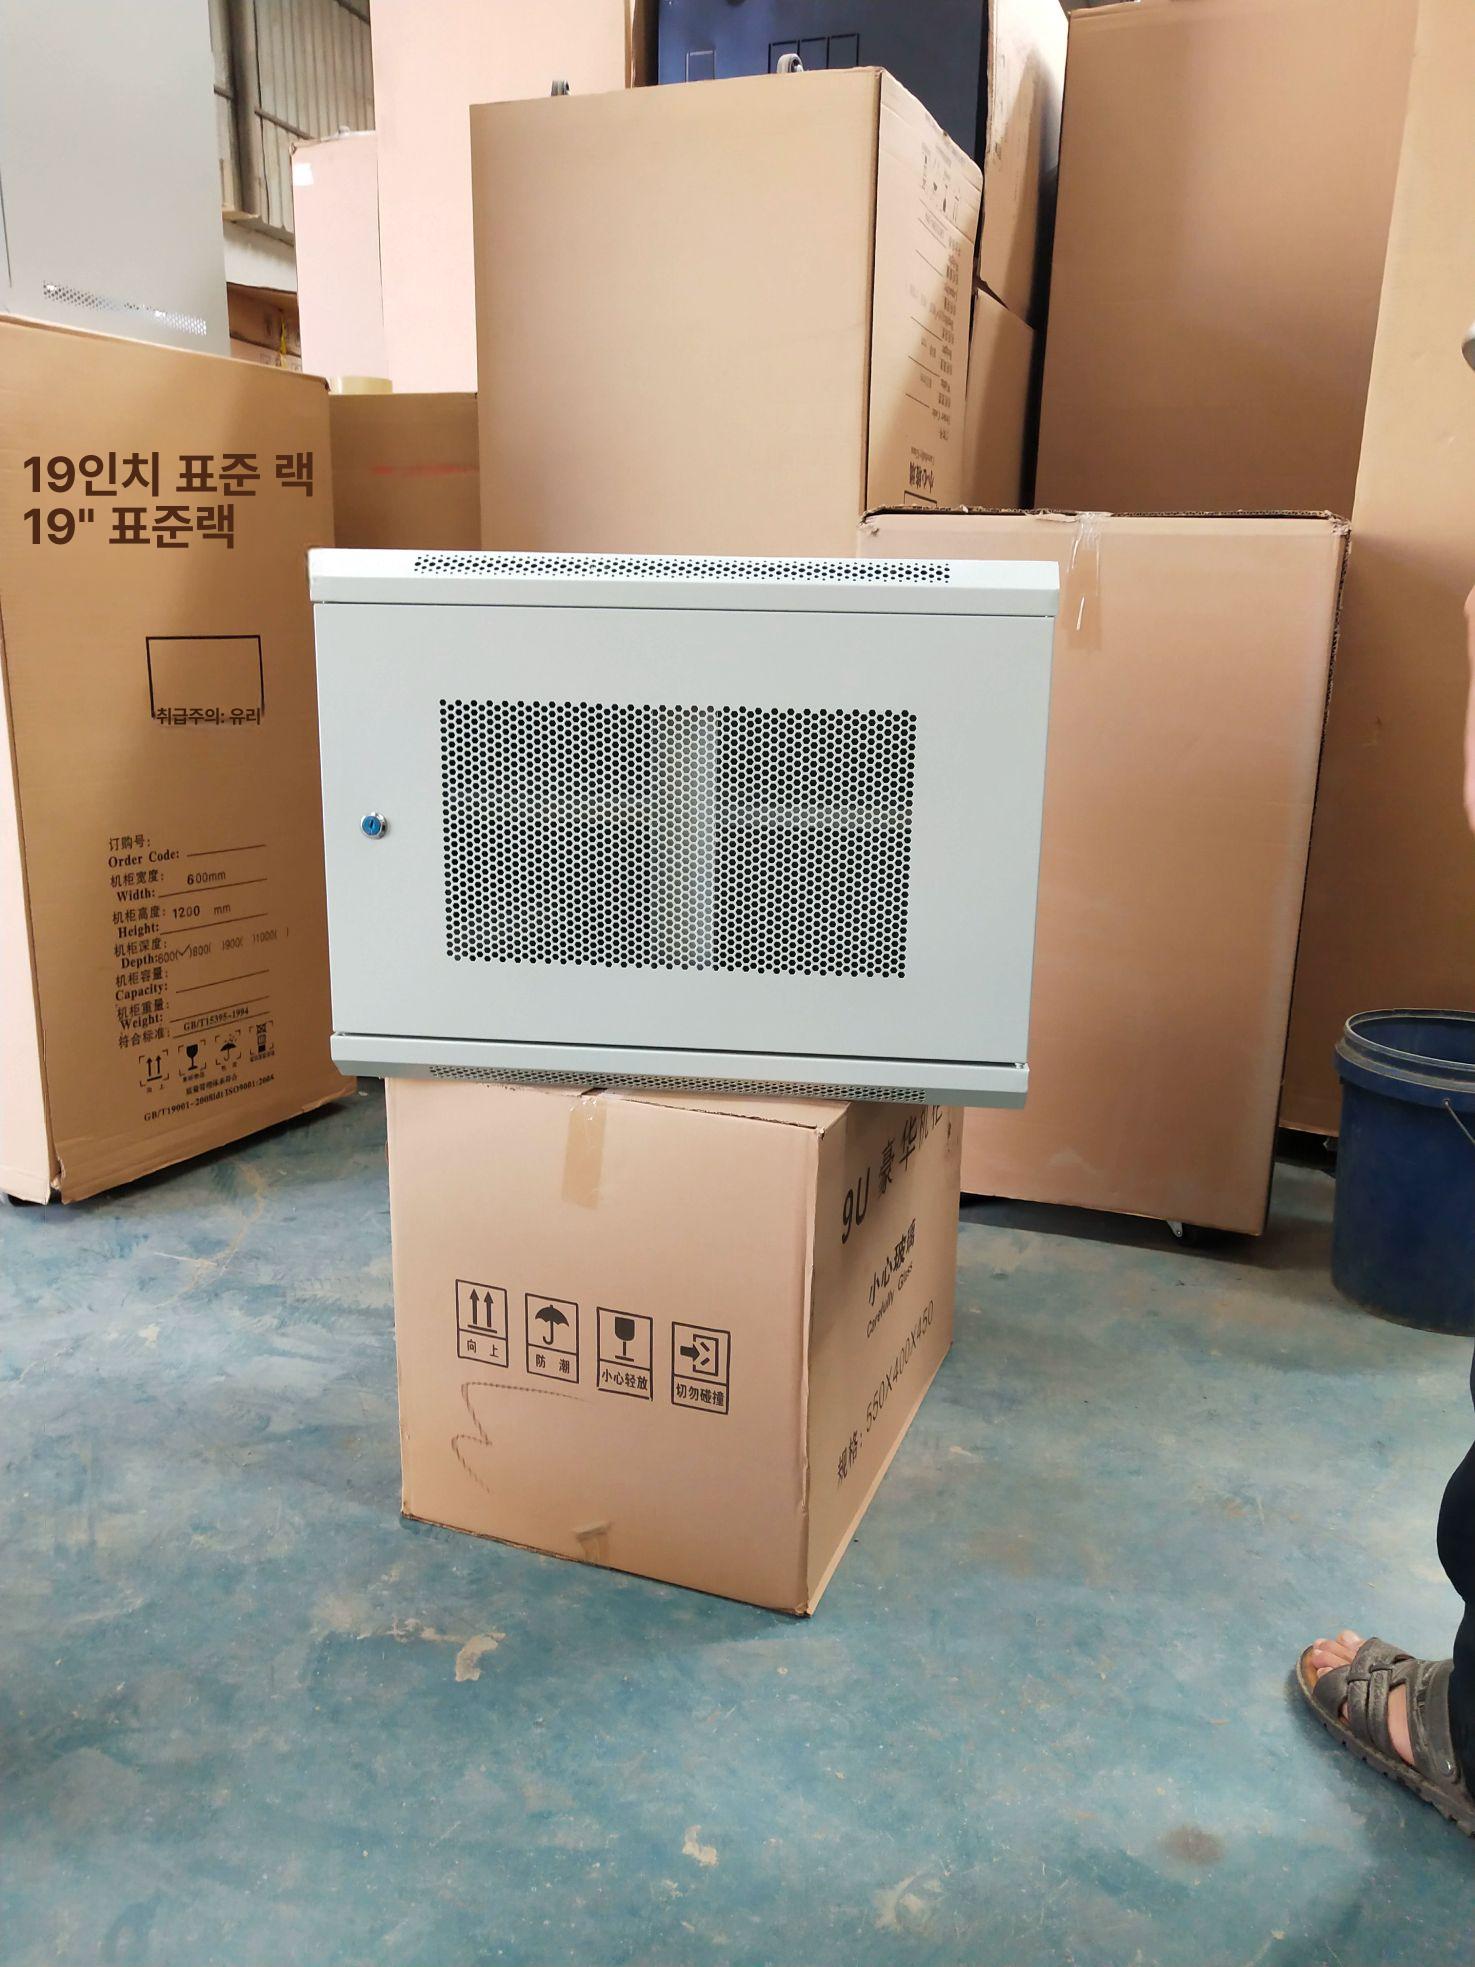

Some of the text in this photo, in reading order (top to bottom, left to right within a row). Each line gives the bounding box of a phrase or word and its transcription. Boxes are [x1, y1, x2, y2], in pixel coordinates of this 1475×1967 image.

[23, 452, 313, 497] 19인치 표준 랙
[23, 504, 234, 549] 19" 표준랙
[156, 708, 261, 726] 취급주의: 유리
[108, 849, 180, 868] Order Code:
[187, 871, 226, 885] 600mm
[117, 889, 155, 902] Width:
[173, 905, 200, 919] 1200
[214, 904, 231, 915] mm
[118, 923, 159, 939] Height:
[115, 983, 168, 1001] Capacity:
[120, 1014, 163, 1030] Weight:
[841, 1167, 871, 1244] 9U
[602, 1367, 648, 1390] 小心轻放
[676, 1383, 724, 1406] 切勿碰撞
